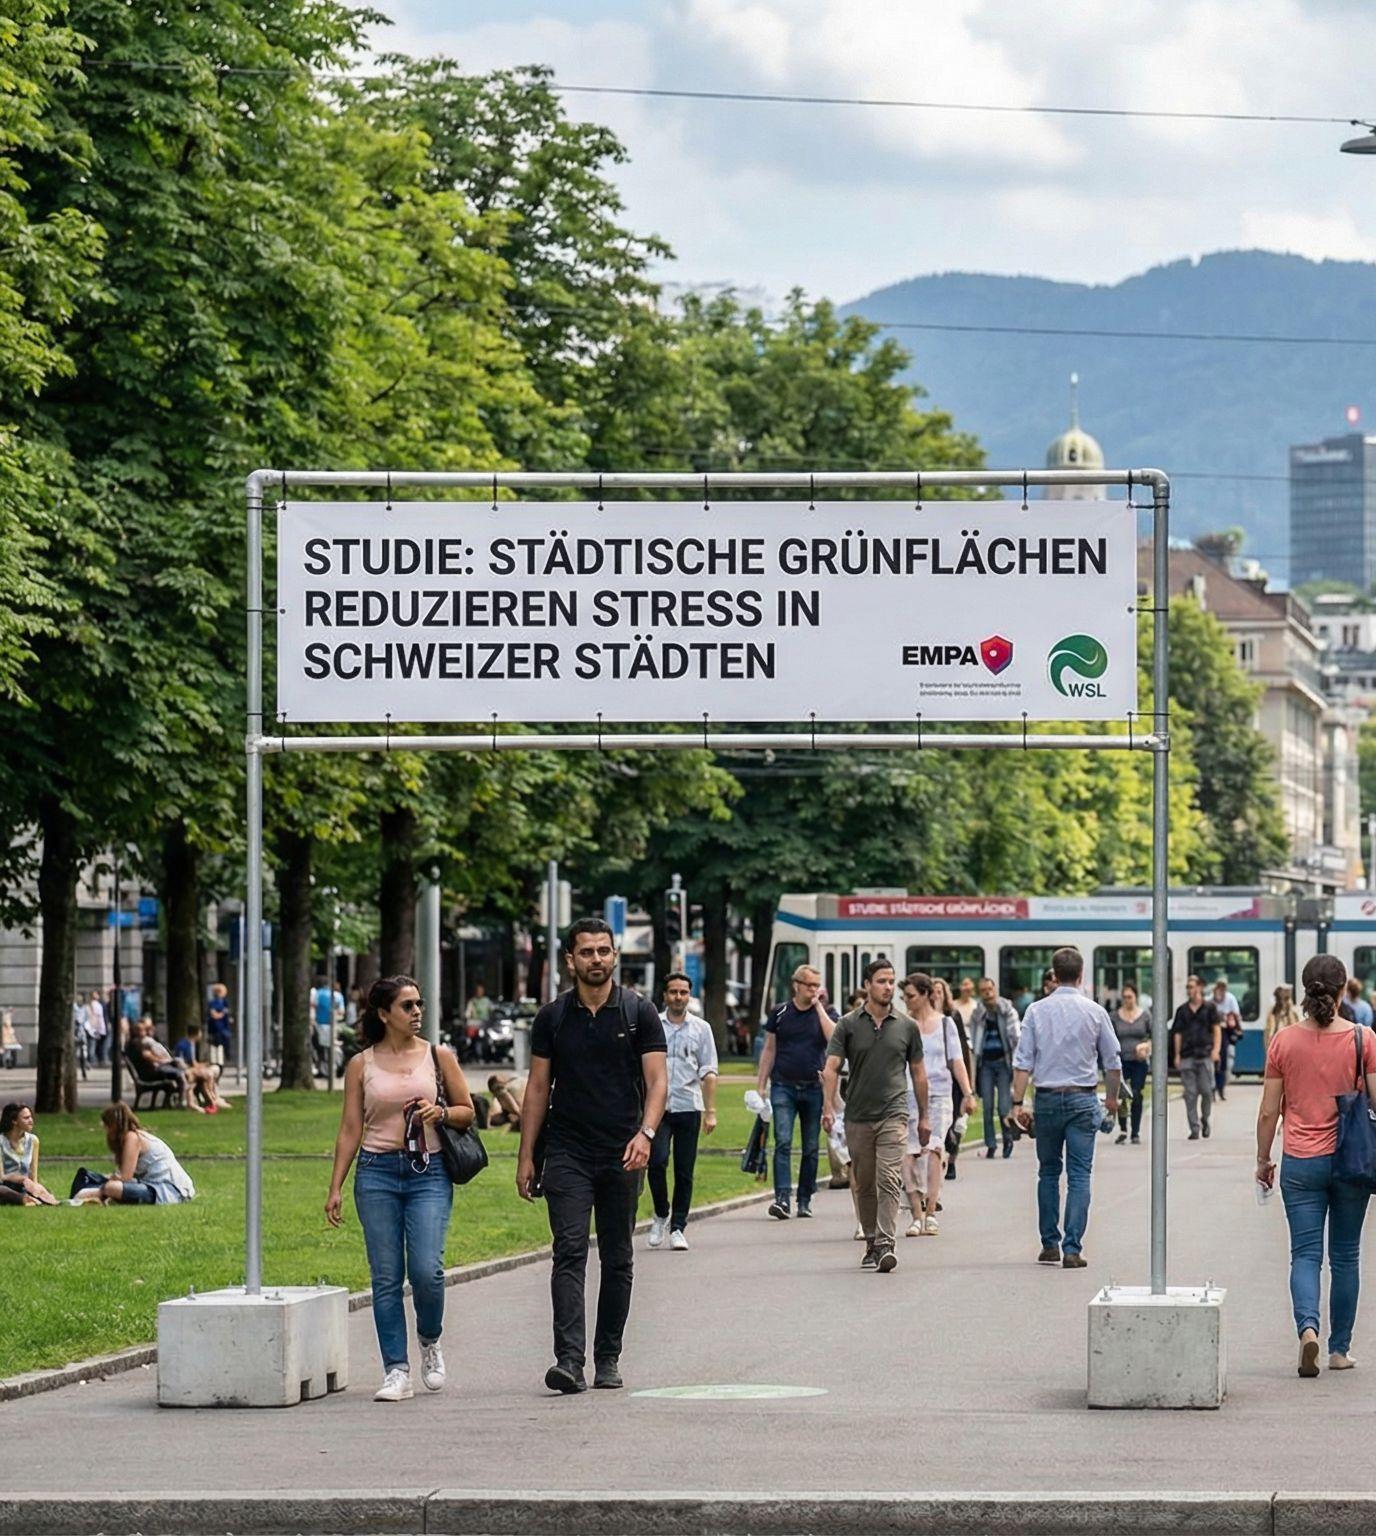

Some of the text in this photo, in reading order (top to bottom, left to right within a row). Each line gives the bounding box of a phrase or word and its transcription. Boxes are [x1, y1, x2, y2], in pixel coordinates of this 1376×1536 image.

[303, 529, 1107, 576] STUDIE: STÄDTISCHE GRÜNFLÄCHEN
[305, 590, 820, 628] REDUZIEREN STRESS IN
[303, 634, 775, 680] SCHWEIZER STÄDTEN
[902, 645, 979, 666] EMPA
[1068, 683, 1107, 698] WSL
